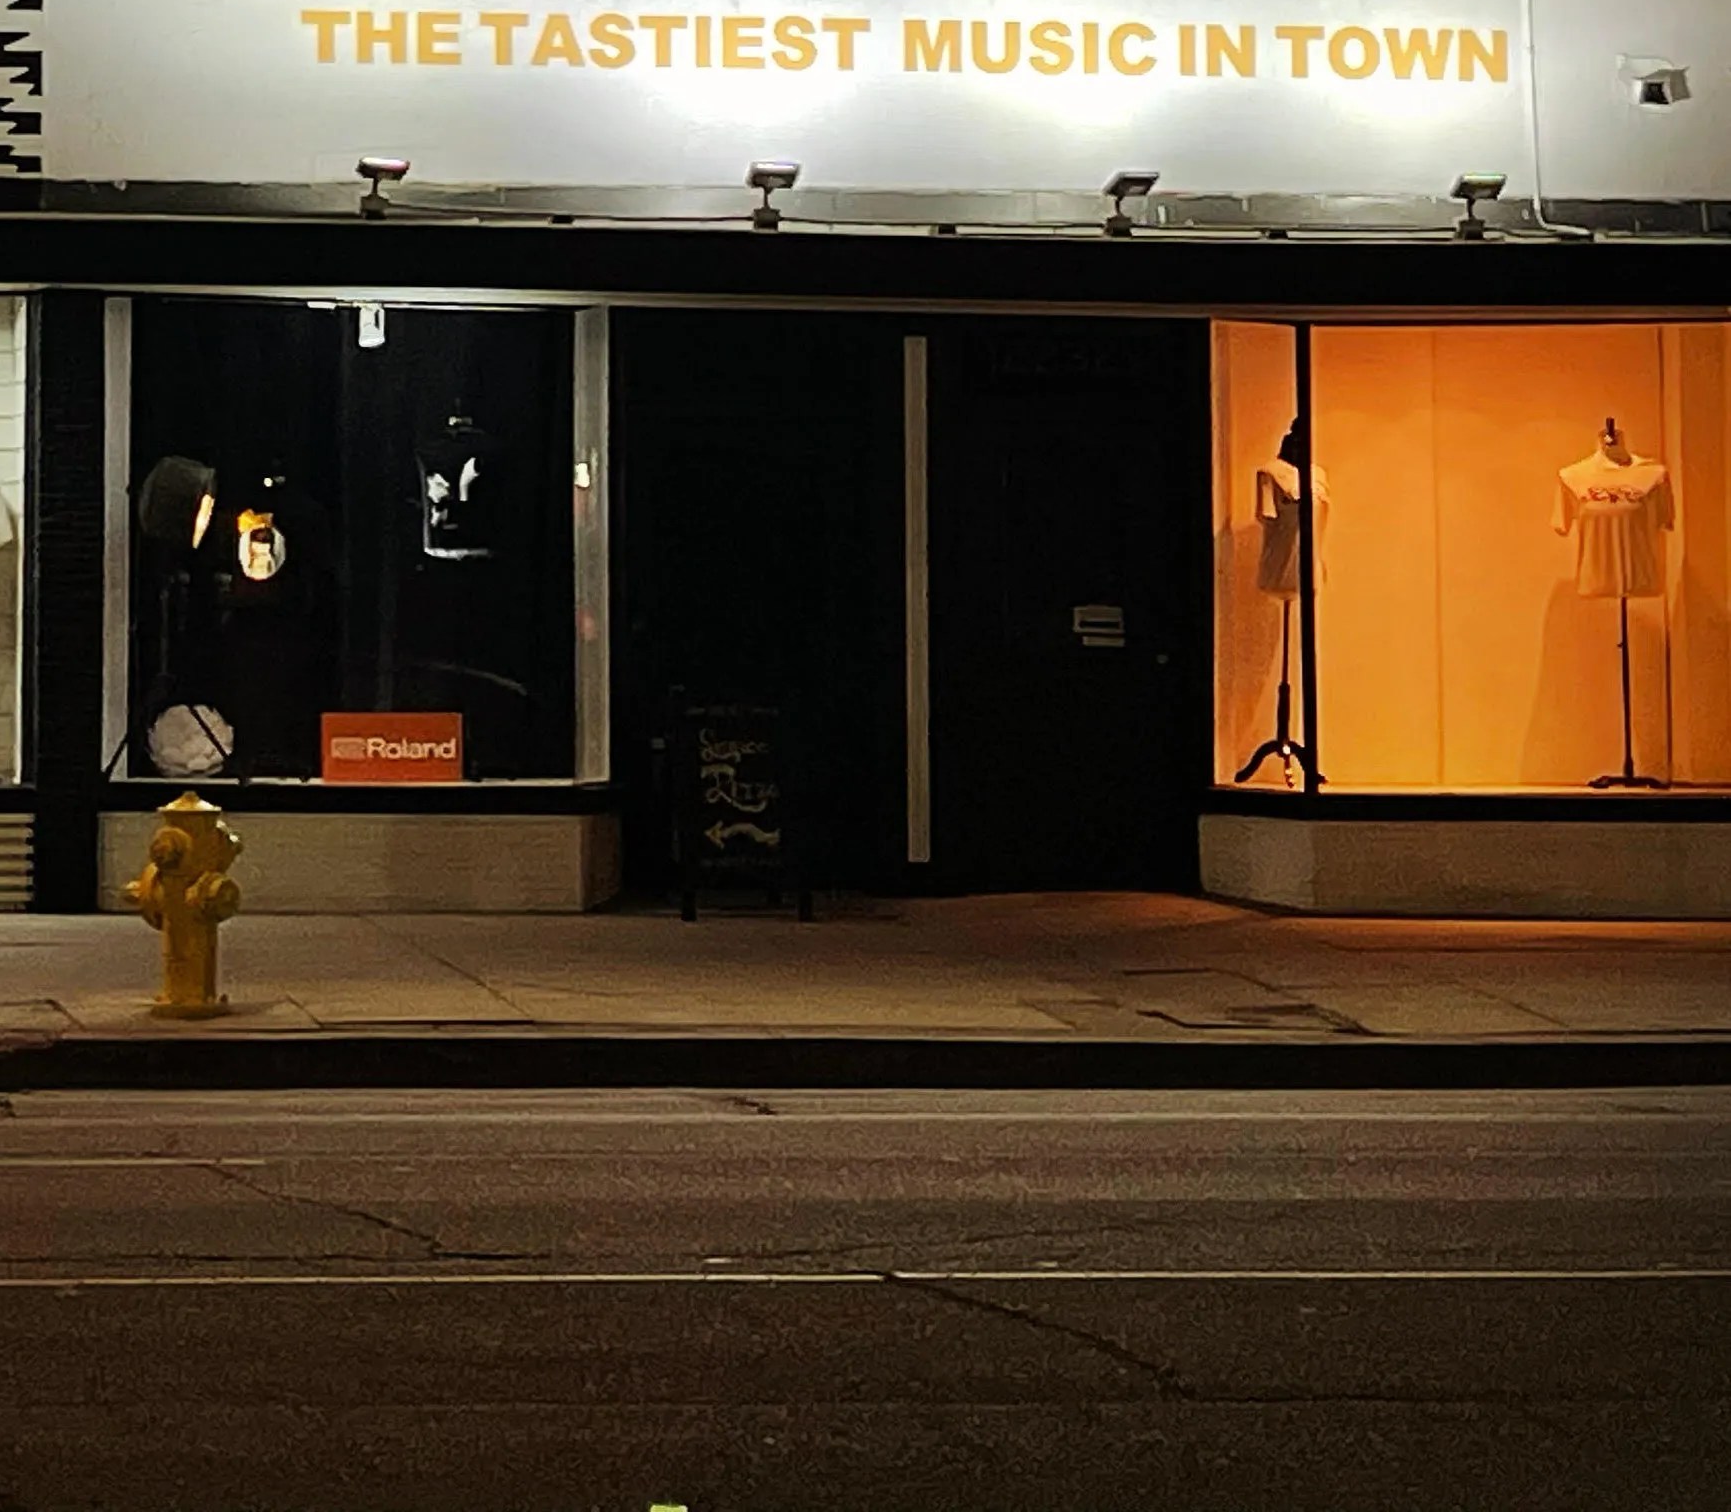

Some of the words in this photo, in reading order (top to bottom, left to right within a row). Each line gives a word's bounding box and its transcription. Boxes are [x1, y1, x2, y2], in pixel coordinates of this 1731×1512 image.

[301, 9, 462, 66] THE
[479, 12, 870, 70] TASTIEST
[902, 19, 1157, 76] MUSIC
[1178, 24, 1256, 78] IN
[1275, 25, 1509, 83] TOWN
[366, 736, 457, 760] Roland
